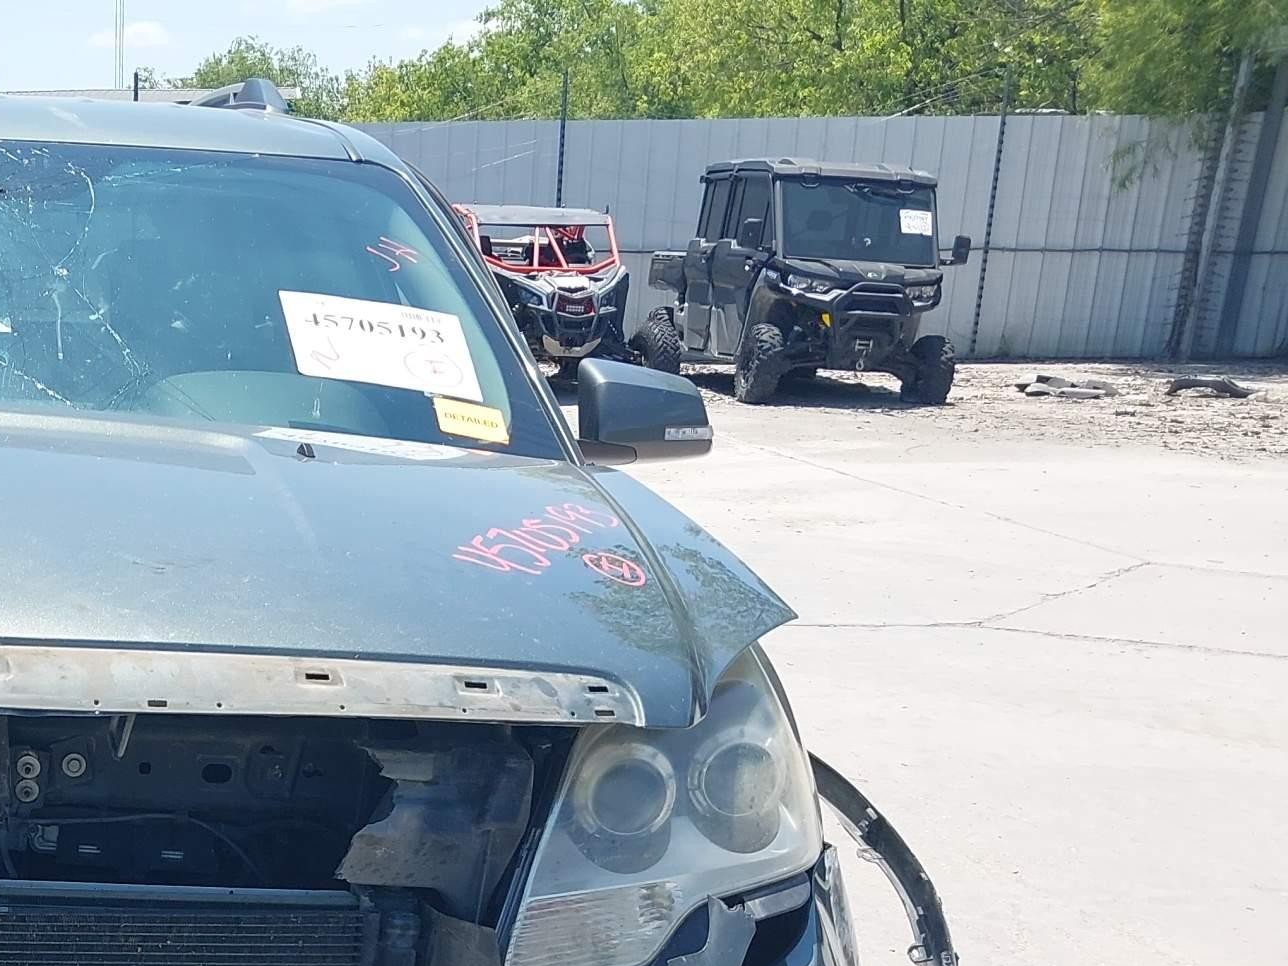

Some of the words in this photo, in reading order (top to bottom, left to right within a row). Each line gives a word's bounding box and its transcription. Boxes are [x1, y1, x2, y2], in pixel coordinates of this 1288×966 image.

[304, 312, 446, 346] 45705193
[443, 411, 499, 429] DETAILED
[451, 503, 619, 575] 45705193
